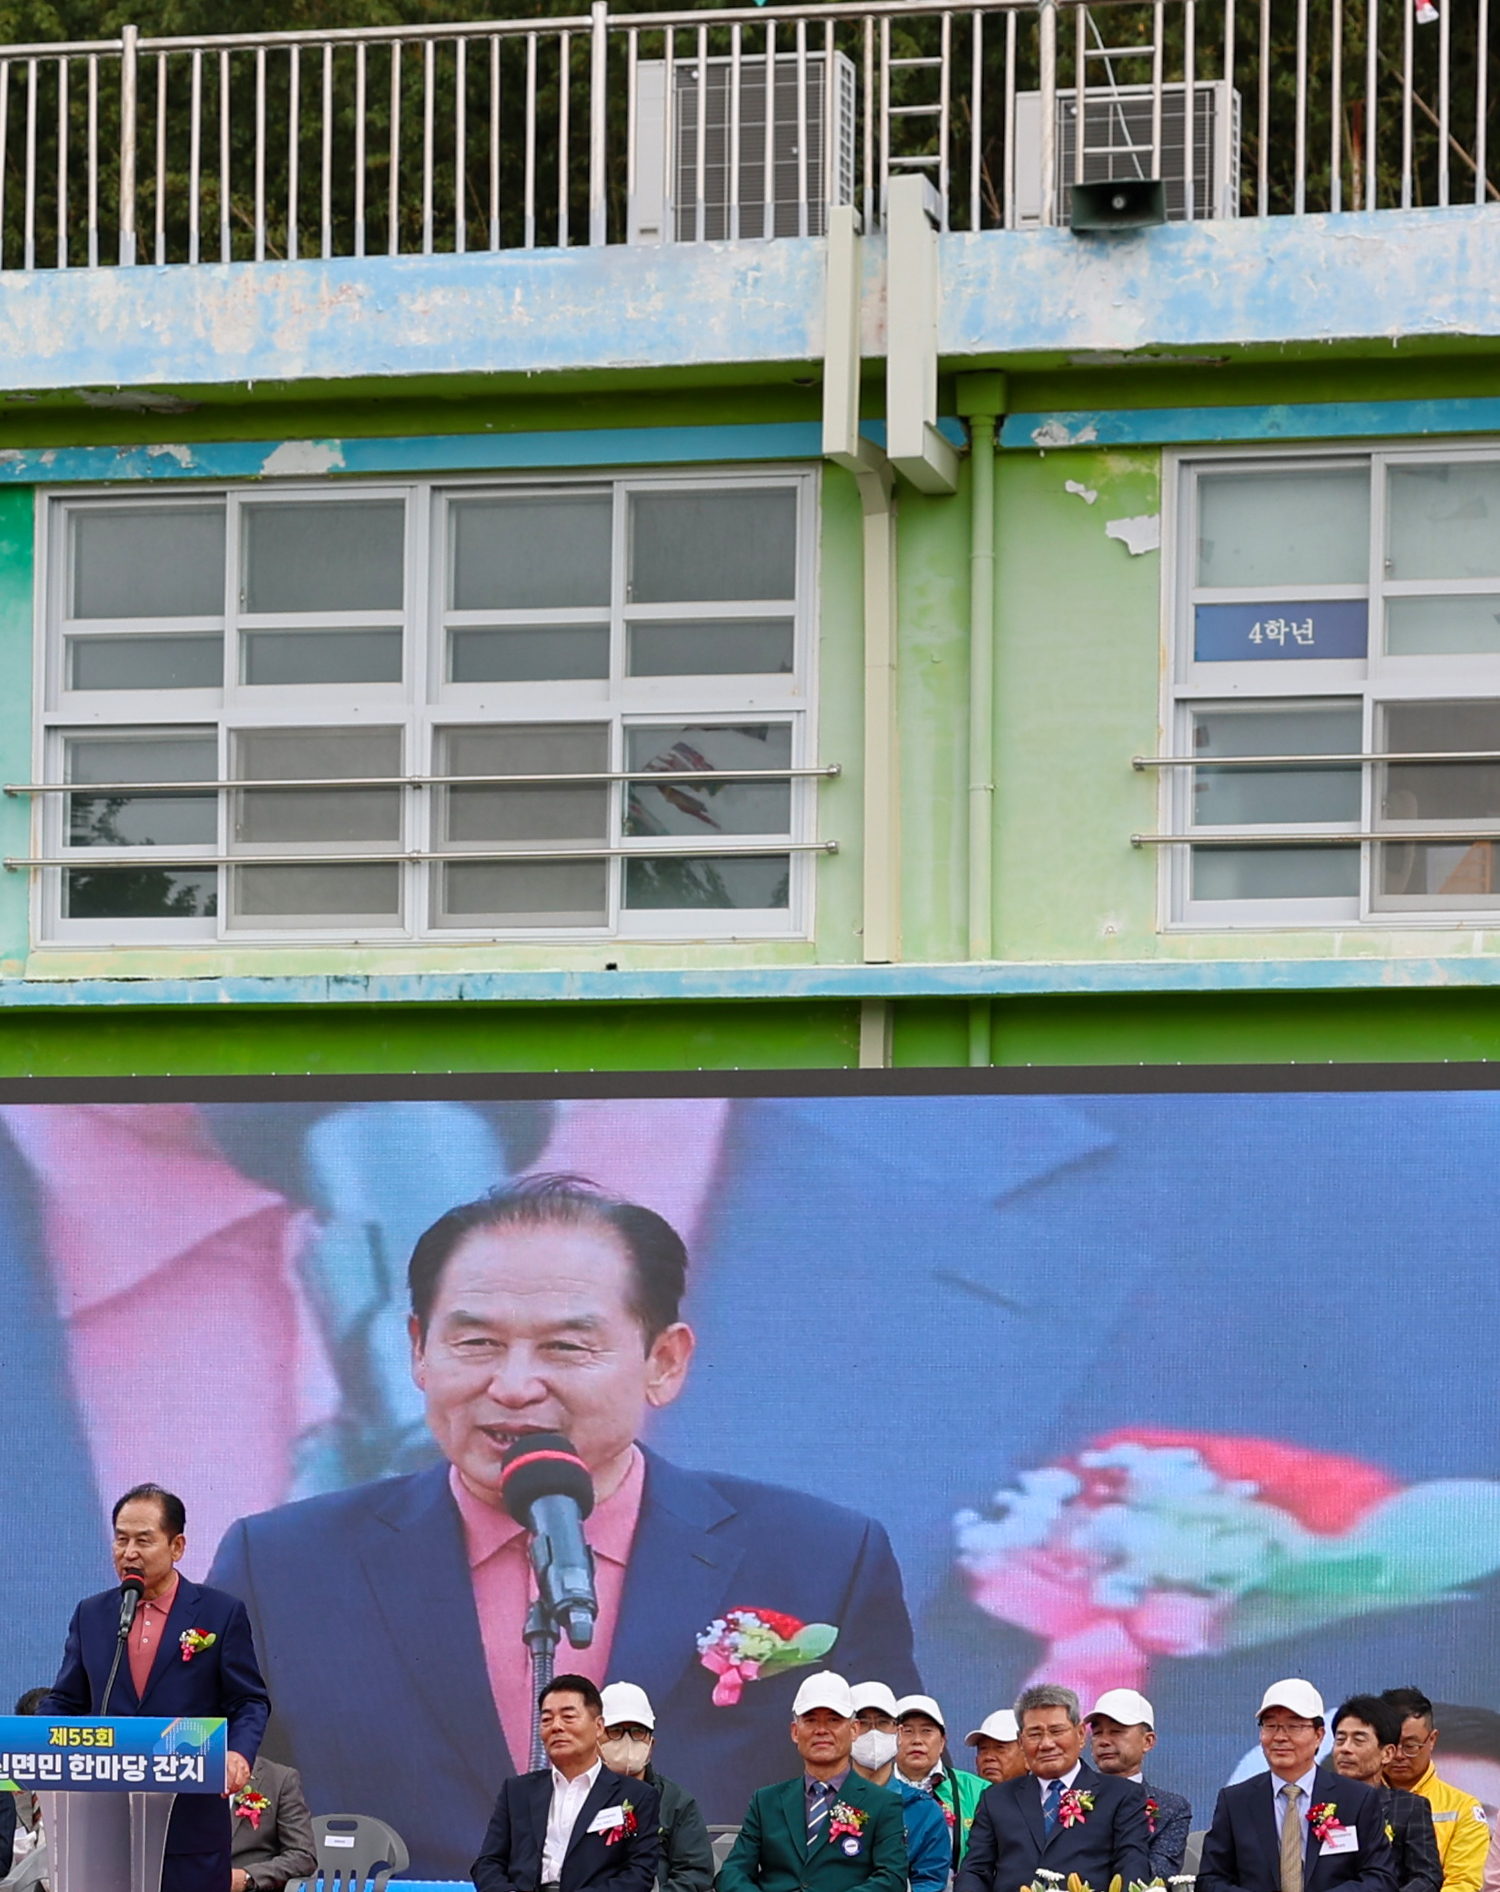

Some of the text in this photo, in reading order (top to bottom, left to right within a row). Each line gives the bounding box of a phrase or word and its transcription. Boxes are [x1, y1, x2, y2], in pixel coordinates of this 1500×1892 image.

[1248, 618, 1315, 646] 4학년
[48, 1726, 114, 1748] 제55회
[67, 1754, 148, 1782] 한마당
[152, 1755, 205, 1783] 잔치
